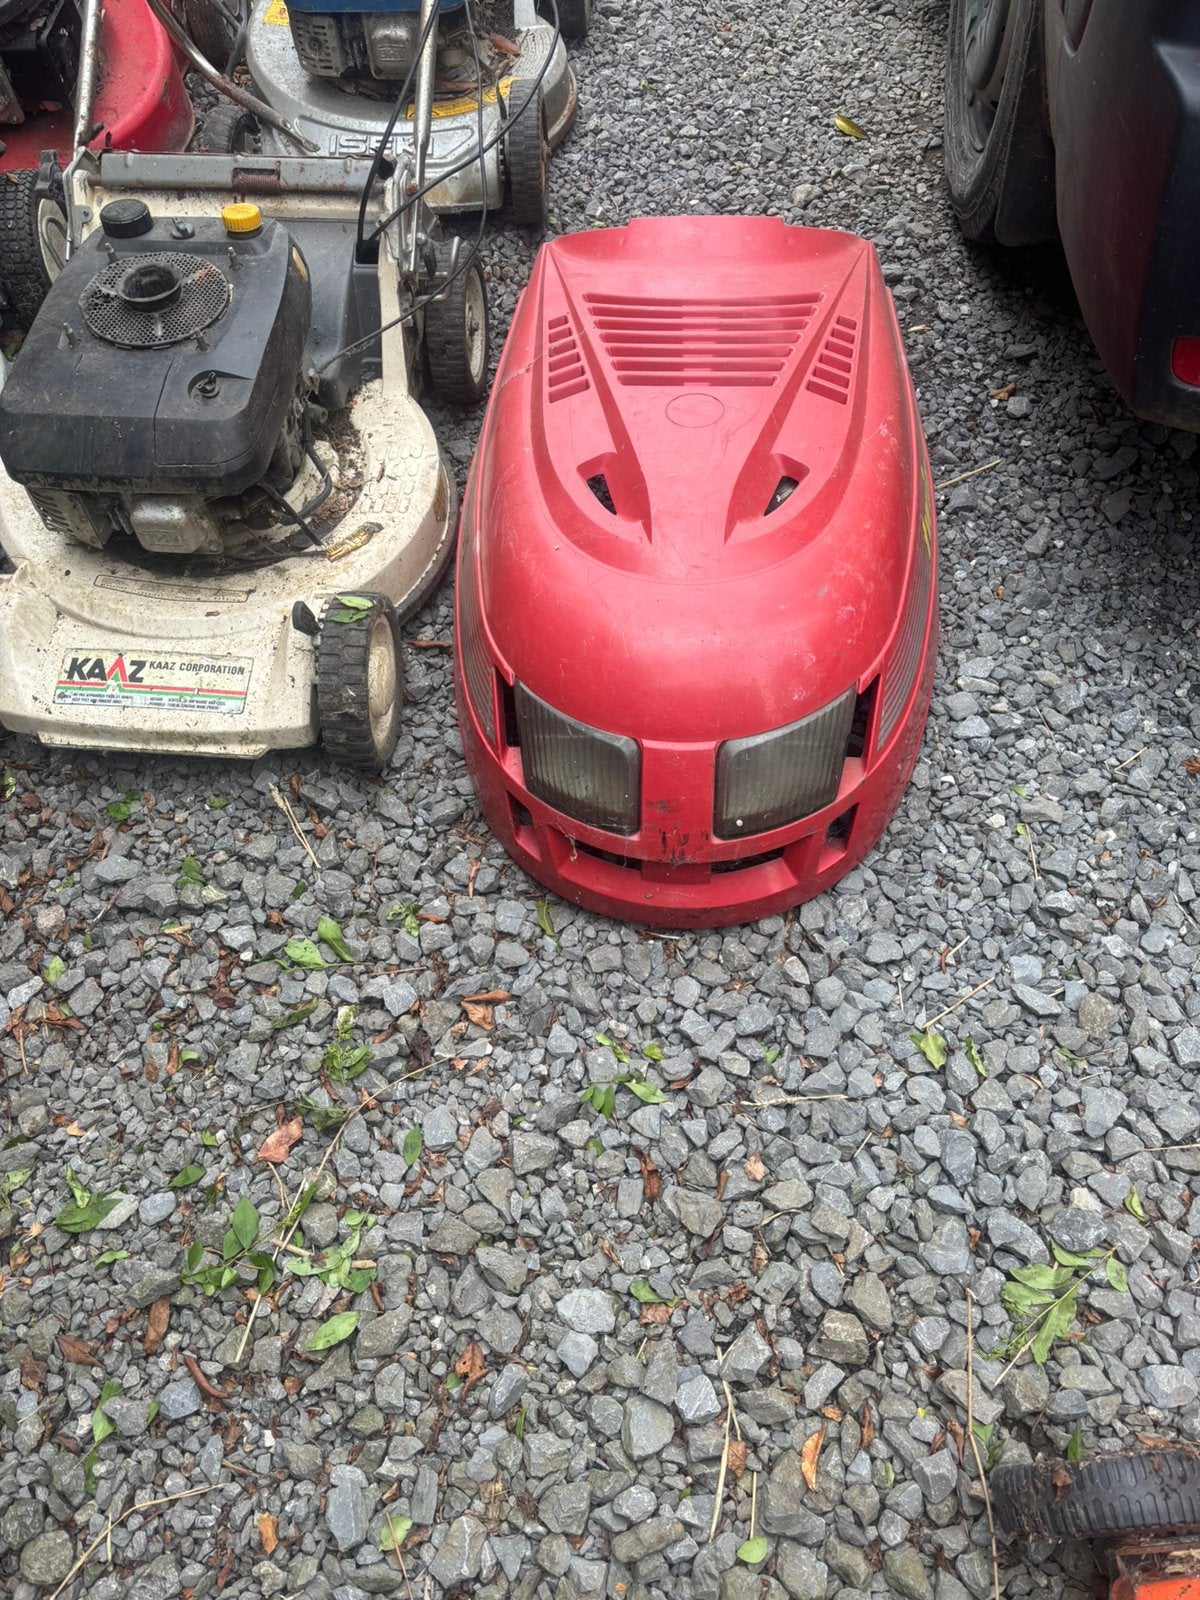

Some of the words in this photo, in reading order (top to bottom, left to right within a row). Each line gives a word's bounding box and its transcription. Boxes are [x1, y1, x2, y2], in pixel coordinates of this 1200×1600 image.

[329, 135, 434, 157] ISEKI
[67, 655, 147, 683] KAAZ
[149, 661, 176, 671] KAAZ
[179, 662, 245, 676] CORPORATION
